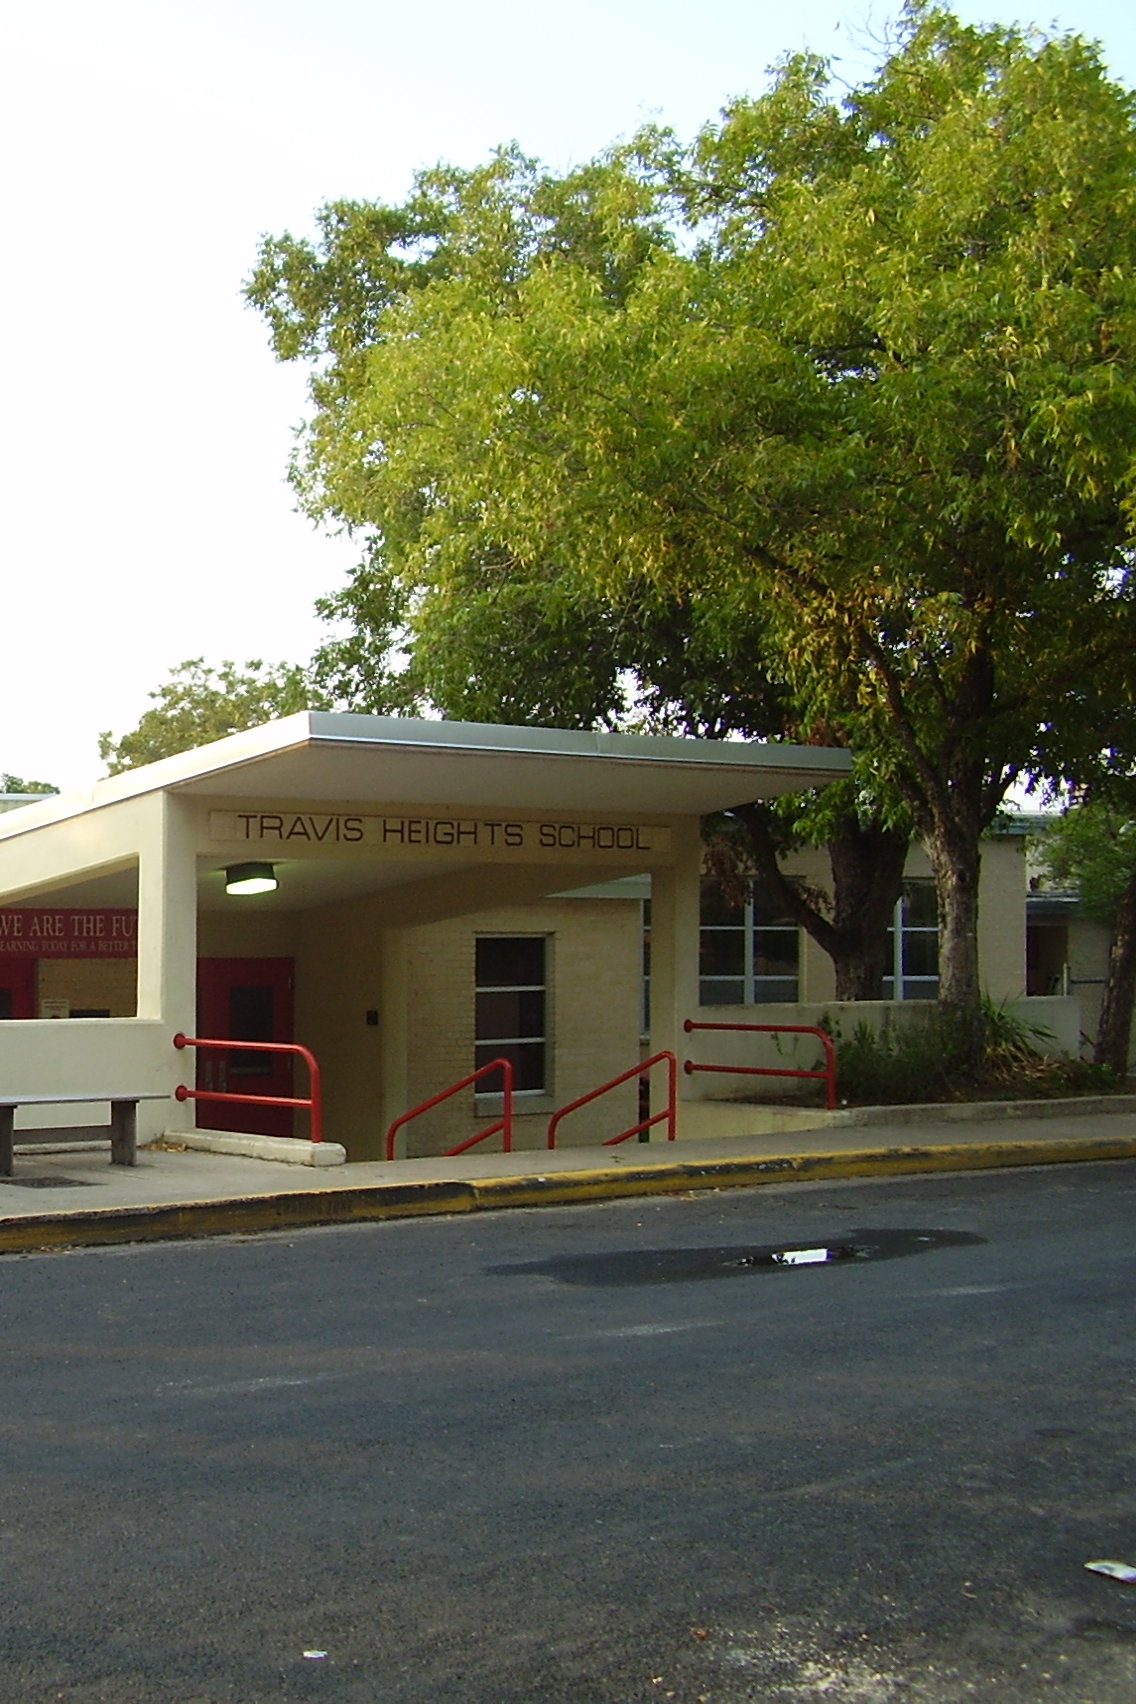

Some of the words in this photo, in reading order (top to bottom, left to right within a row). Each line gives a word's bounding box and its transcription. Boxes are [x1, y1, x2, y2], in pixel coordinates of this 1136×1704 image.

[237, 813, 364, 842] TRAVIS
[382, 819, 524, 847] HEIGHTS
[538, 824, 652, 851] SCHOOL
[29, 914, 64, 937] ARE
[71, 915, 105, 937] THE
